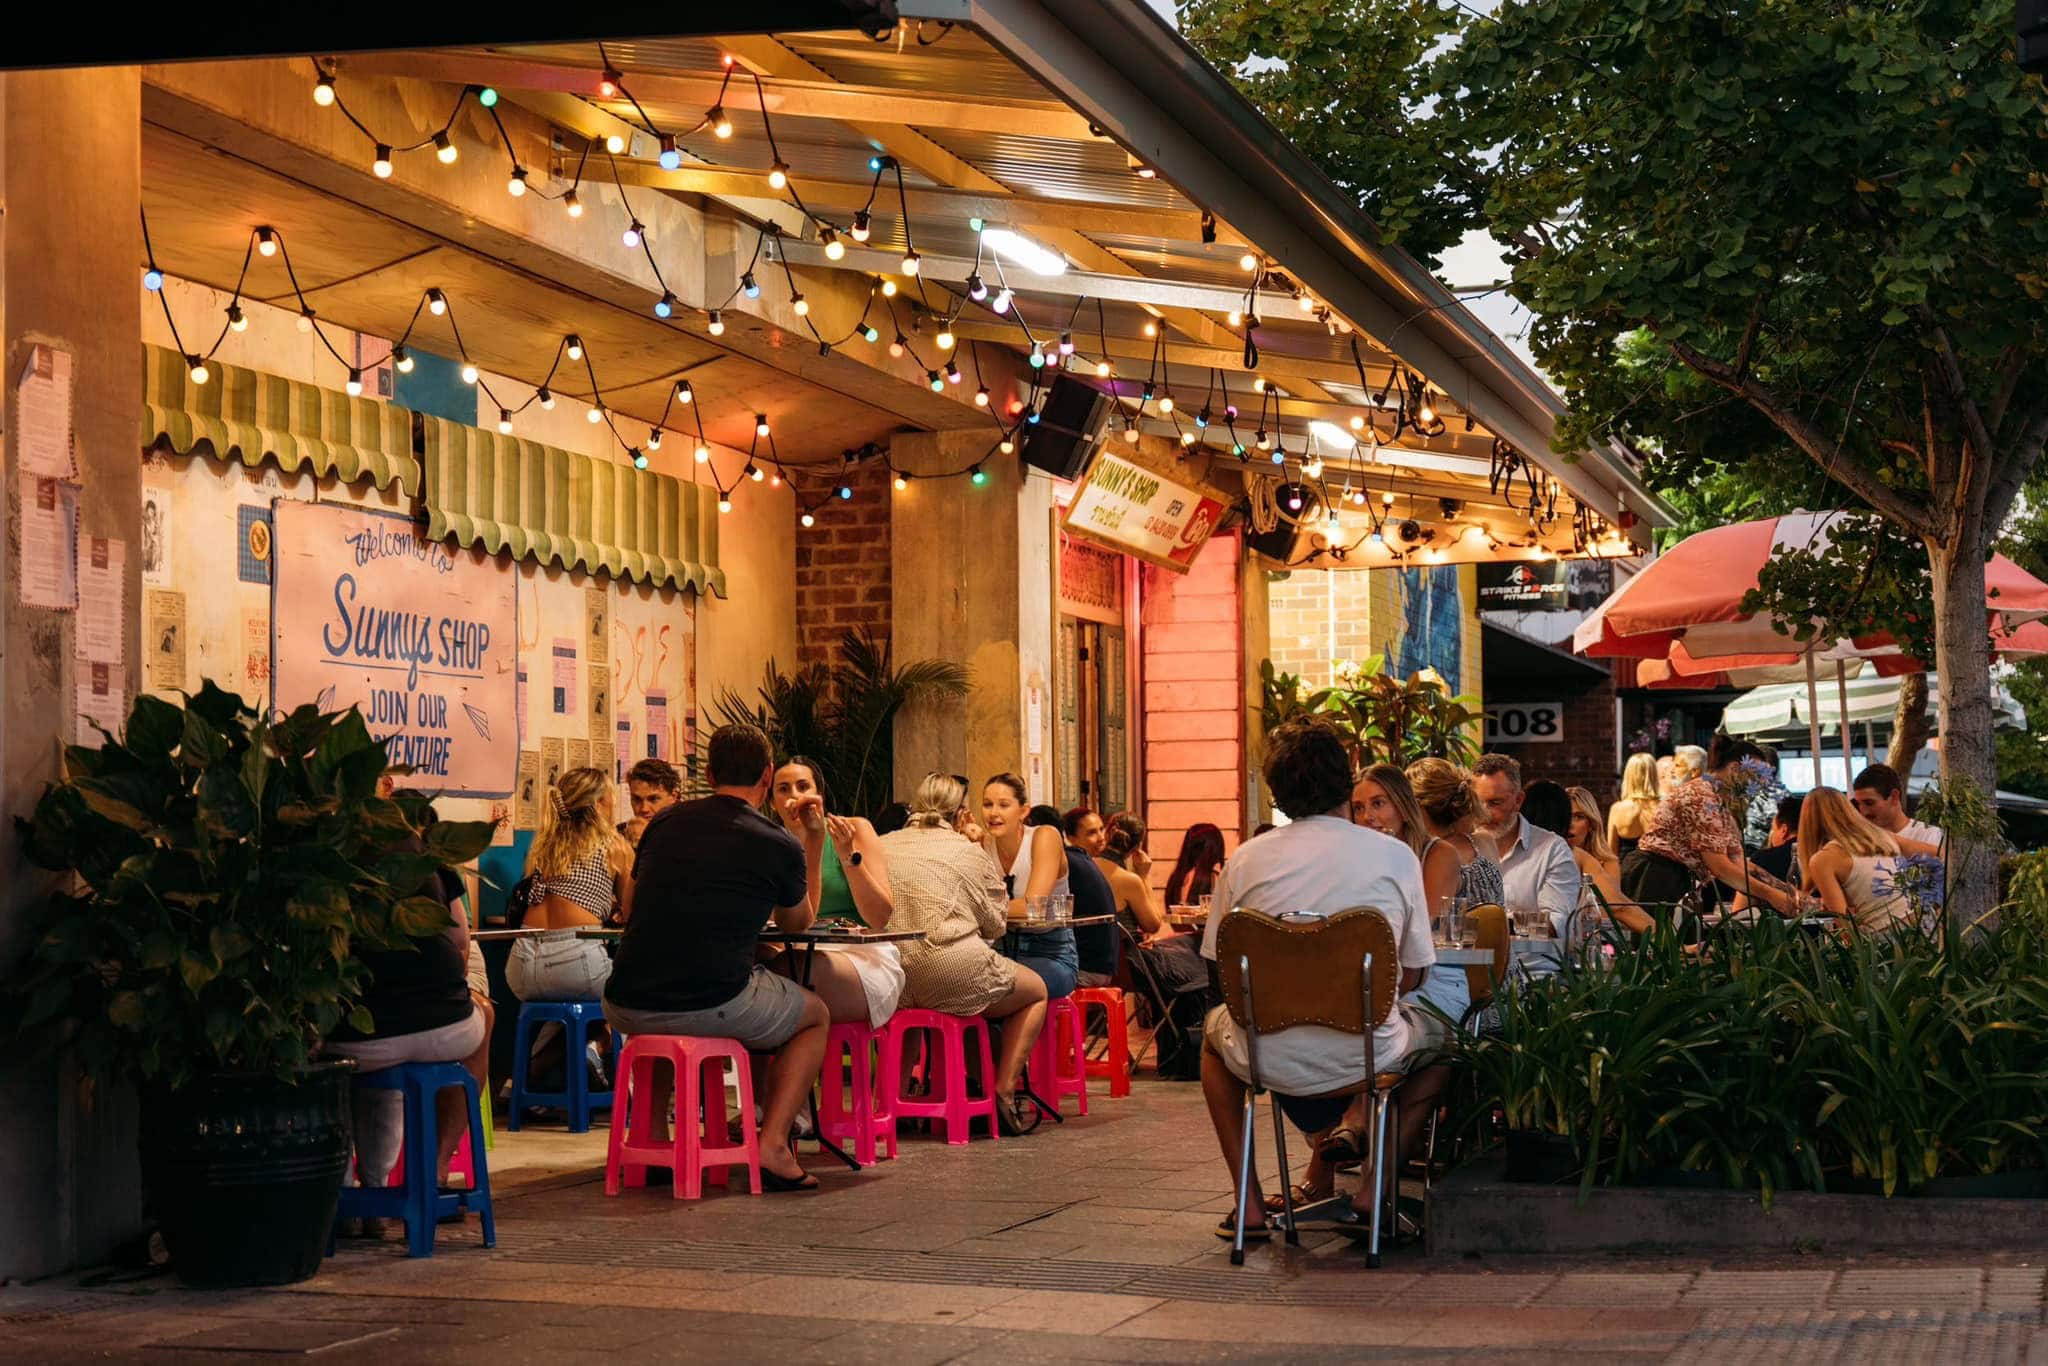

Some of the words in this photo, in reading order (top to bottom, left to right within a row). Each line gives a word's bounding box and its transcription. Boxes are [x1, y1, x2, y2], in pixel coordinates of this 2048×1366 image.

[1129, 474, 1160, 507] SHOP
[345, 521, 427, 568] Welcome
[1480, 585, 1522, 596] STRIKE
[1523, 583, 1565, 593] FORCE
[1504, 592, 1541, 600] FITNESS
[438, 617, 490, 670] SHOP
[366, 688, 408, 725] JOIN
[417, 692, 448, 729] OUR
[1487, 709, 1558, 737] 108
